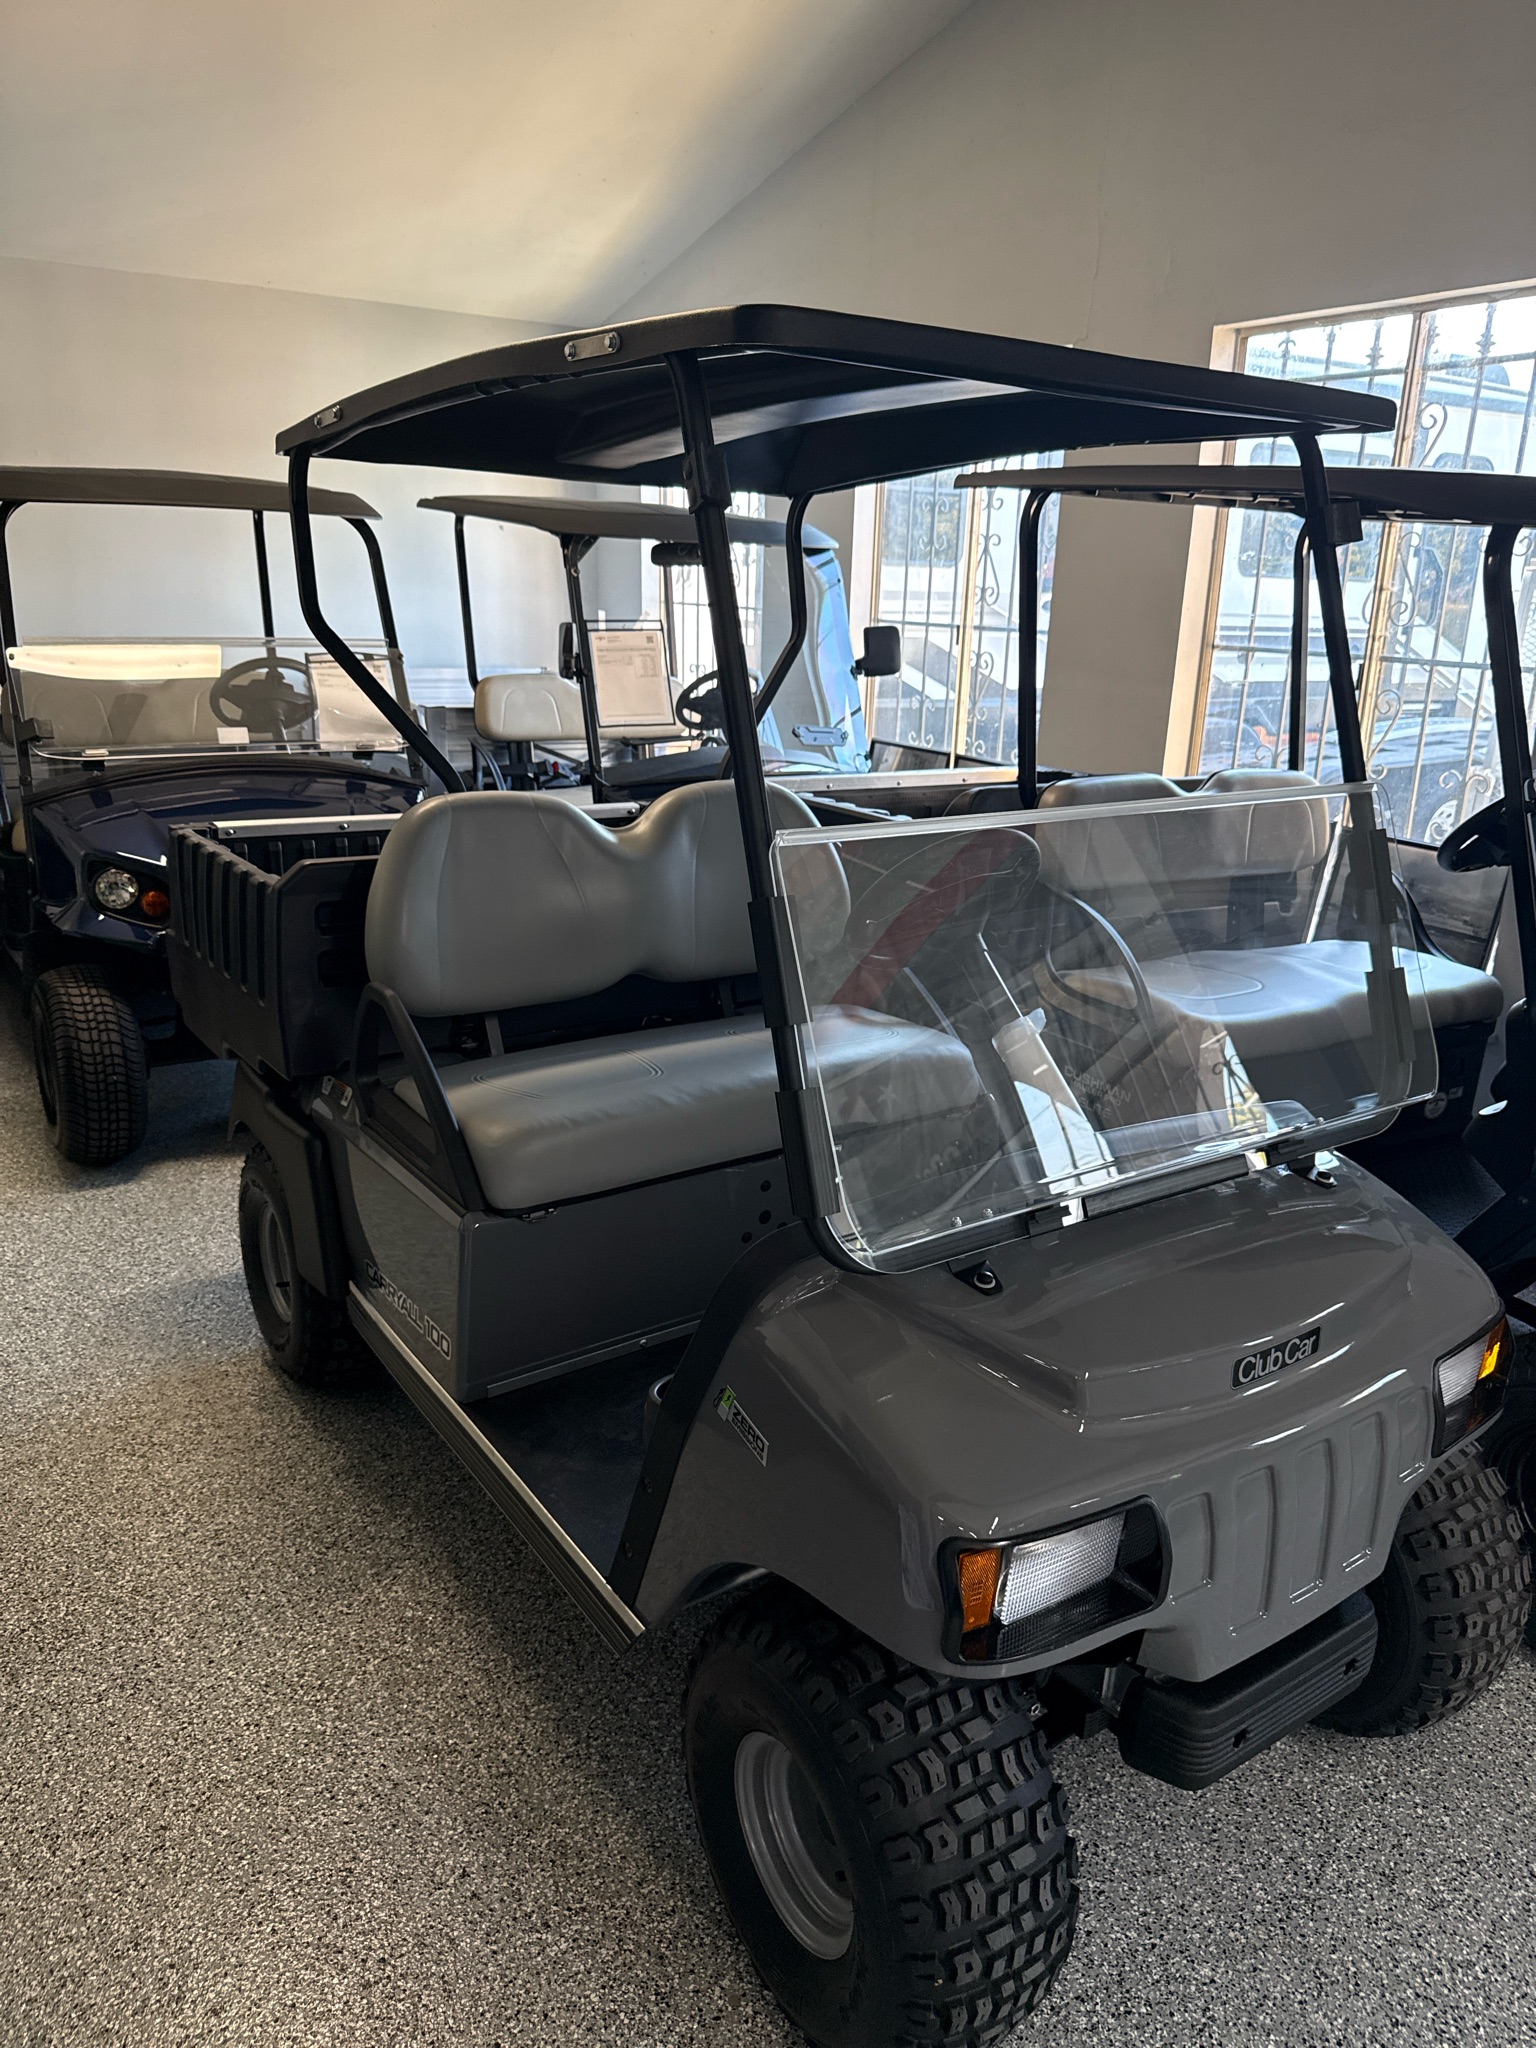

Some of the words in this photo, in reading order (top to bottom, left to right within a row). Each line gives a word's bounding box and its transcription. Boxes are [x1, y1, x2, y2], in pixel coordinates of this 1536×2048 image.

[1064, 1065, 1131, 1103] CUSHMAN
[365, 1259, 424, 1334] CARRYALL
[424, 1314, 452, 1361] 100
[1238, 1347, 1283, 1383] Club
[1284, 1334, 1317, 1365] Car
[732, 1404, 765, 1454] ZERO
